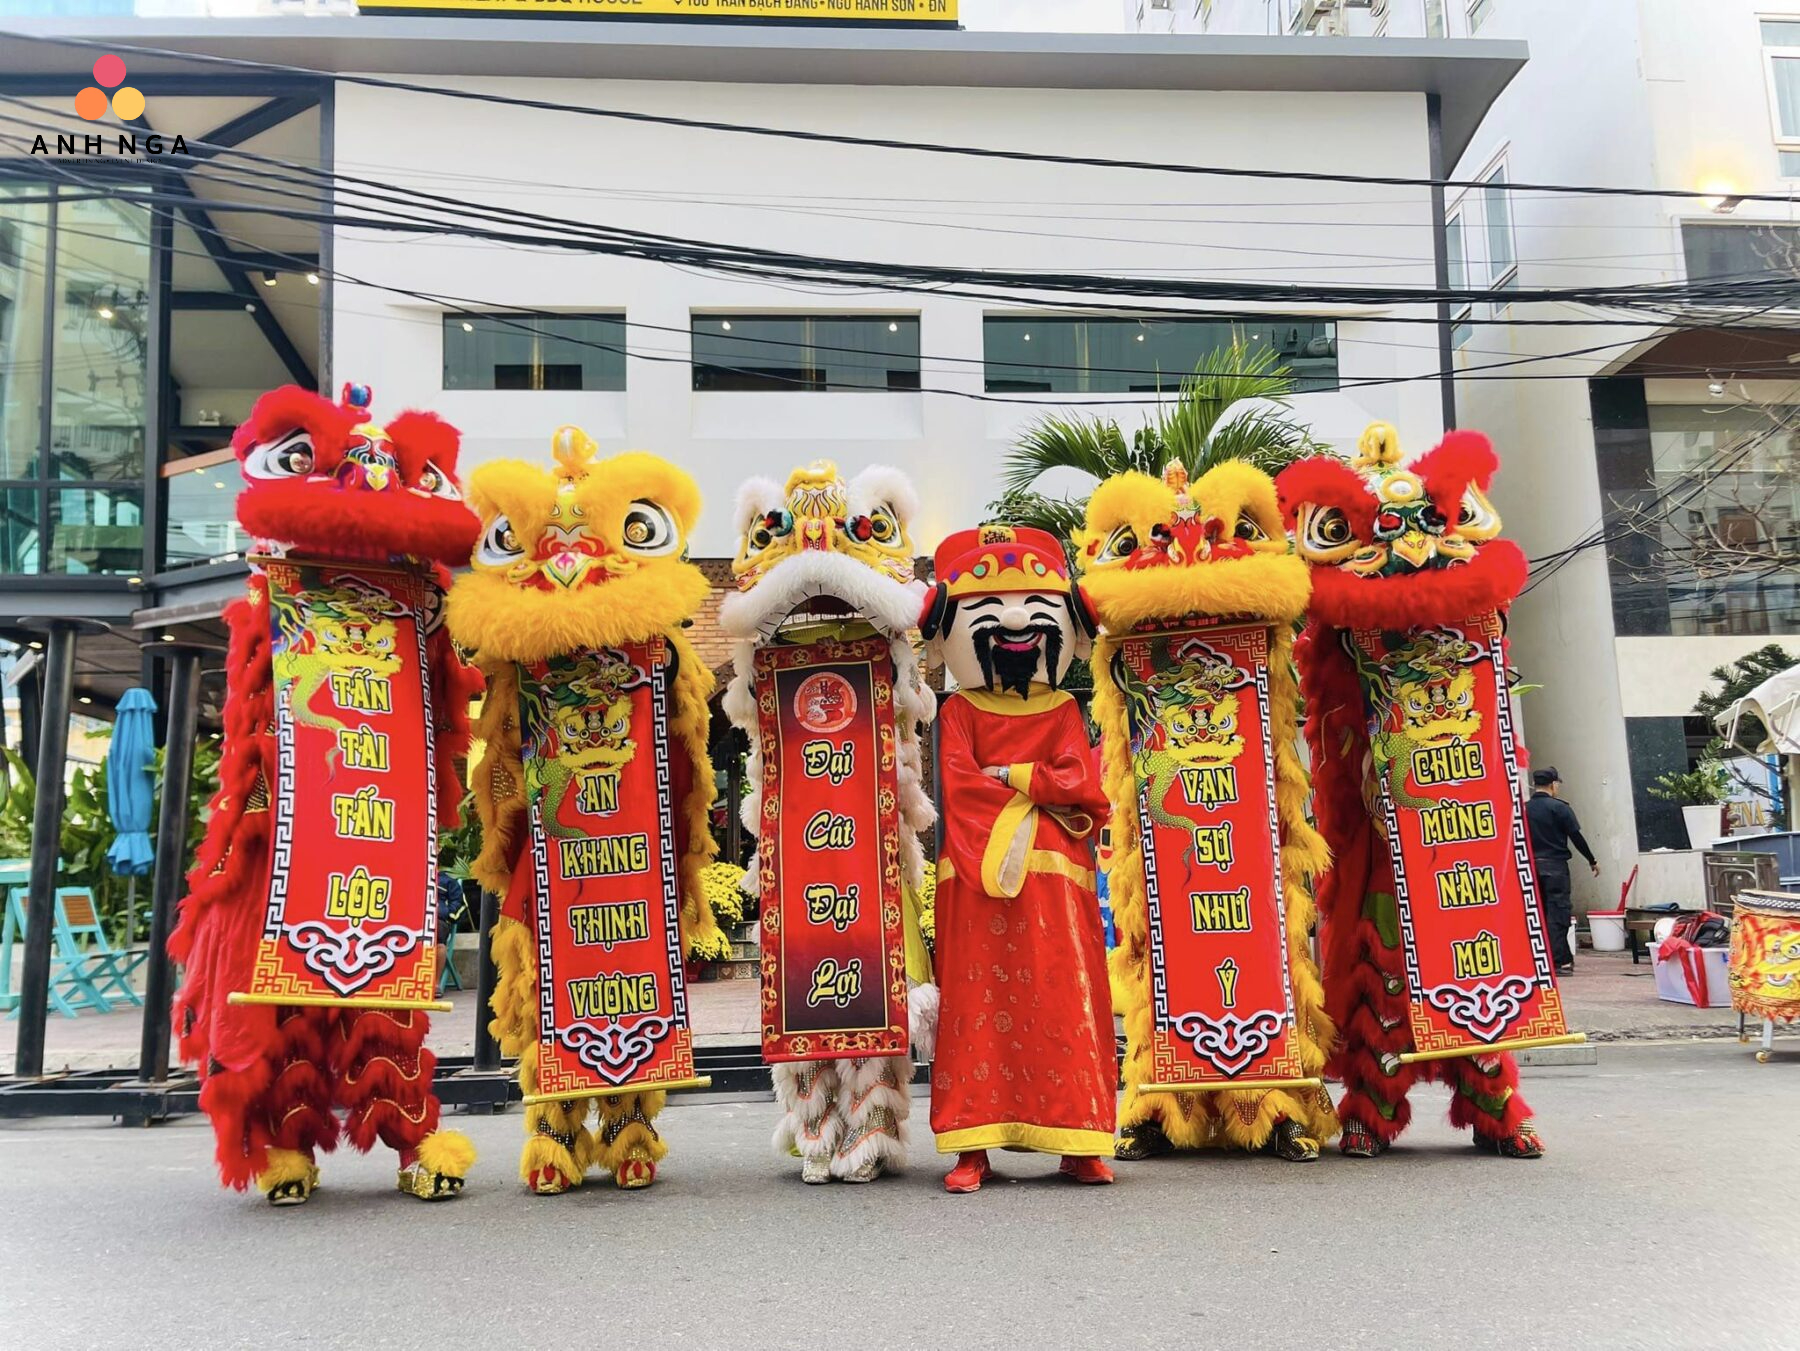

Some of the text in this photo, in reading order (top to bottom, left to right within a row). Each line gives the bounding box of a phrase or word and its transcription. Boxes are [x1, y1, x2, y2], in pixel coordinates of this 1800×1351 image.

[334, 669, 391, 712] TẤN
[340, 727, 388, 770] TÀI
[804, 741, 853, 783] Đại
[1413, 738, 1484, 785] CHÚC
[584, 776, 617, 812] AN
[1181, 767, 1236, 810] VẠN
[334, 788, 394, 839] TẤN
[806, 812, 854, 848] Cát
[1421, 802, 1495, 845] MỪNG
[562, 835, 648, 878] KHANG
[1195, 823, 1233, 871] SỰ
[327, 869, 389, 927] LỘC
[1438, 864, 1497, 907] NĂM
[570, 902, 647, 951] THỊNH
[806, 886, 857, 930] Đại
[1192, 887, 1249, 930] NHƯ
[1453, 932, 1501, 978] MỚI
[568, 973, 657, 1024] VƯỢNG
[808, 959, 860, 1006] Lợi
[1216, 960, 1237, 1006] Ý
